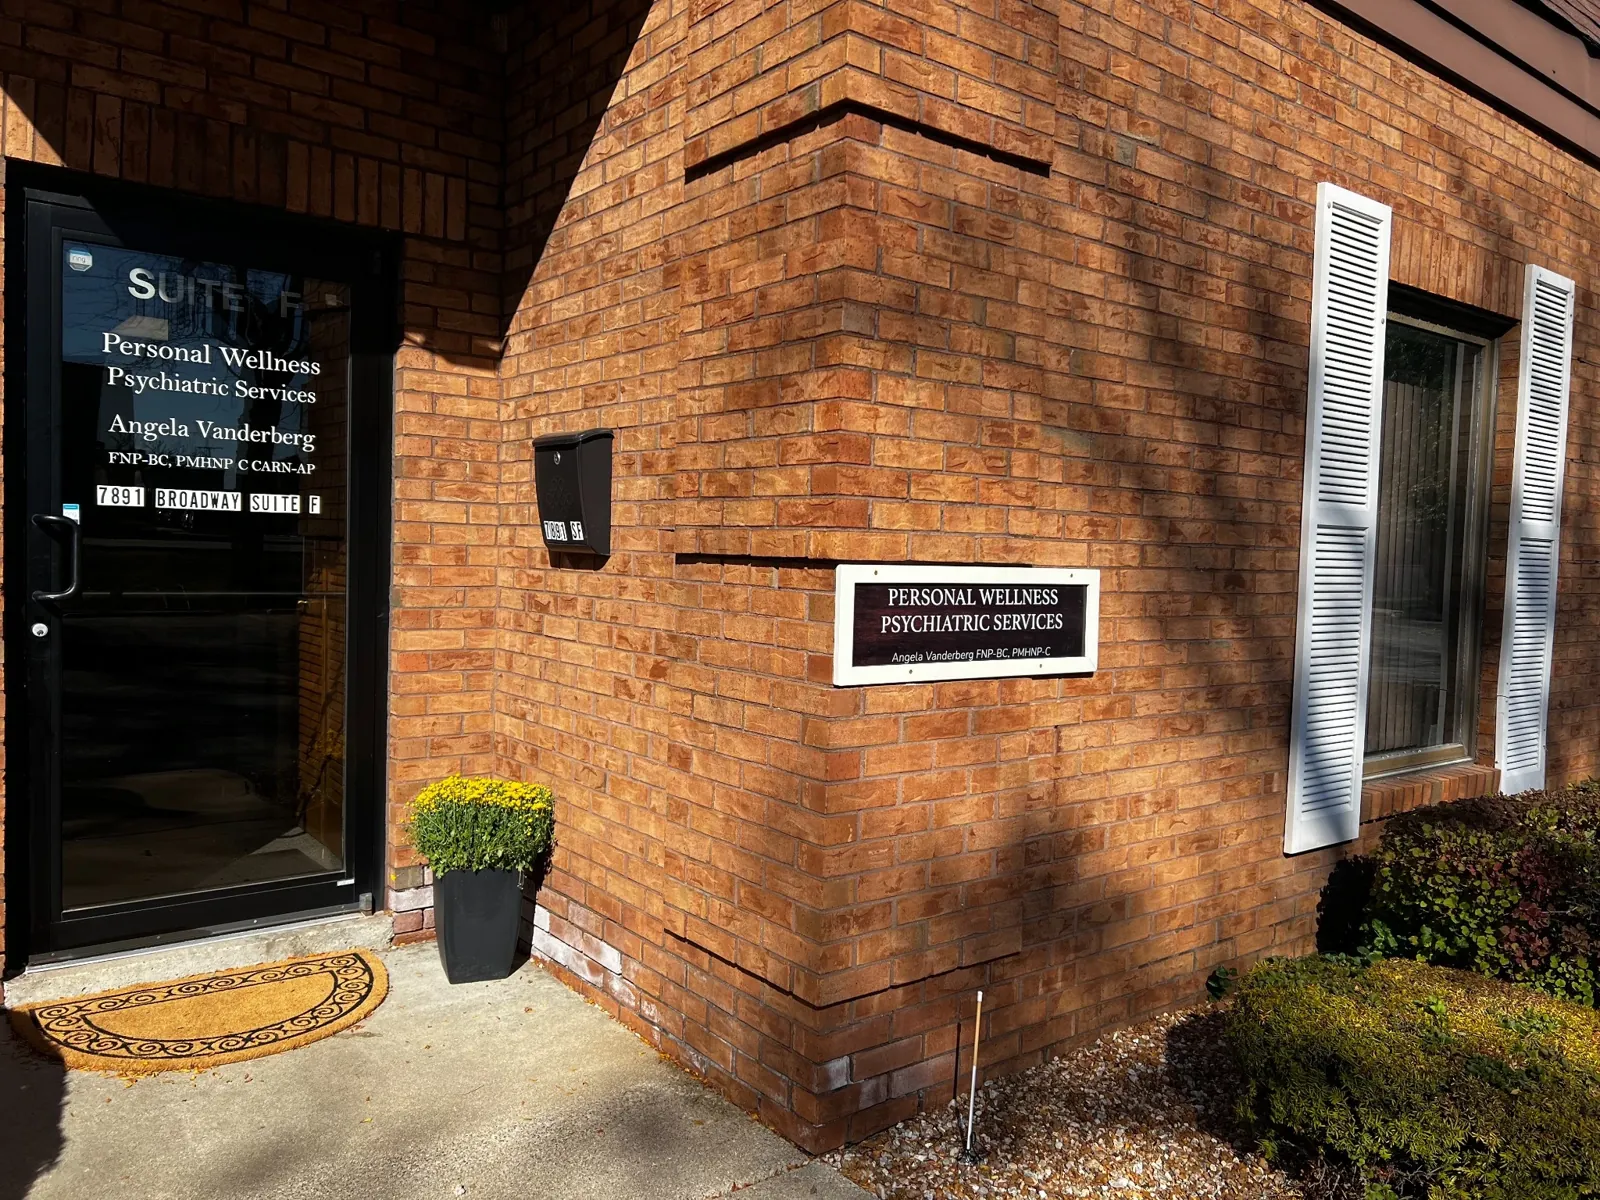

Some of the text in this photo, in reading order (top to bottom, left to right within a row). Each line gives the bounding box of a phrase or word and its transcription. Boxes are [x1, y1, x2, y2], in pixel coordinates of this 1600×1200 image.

[127, 267, 304, 318] SUITE F
[101, 332, 321, 375] Personal Wellness
[107, 366, 317, 404] Psychiatric Services
[108, 414, 316, 452] Angela Vanderberg
[108, 451, 173, 469] FNP-BC,
[176, 455, 233, 471] PMHNP
[251, 460, 316, 476] CARN-AP
[98, 486, 319, 513] 7891 BROADWAY SUITE F
[545, 521, 567, 540] 7891
[888, 588, 1059, 606] PERSONAL WELLNESS
[881, 613, 1063, 633] PSYCHIATRIC SERVICES
[892, 646, 1052, 664] Angela Vanderberg FNP-BC, PMHNP-C
